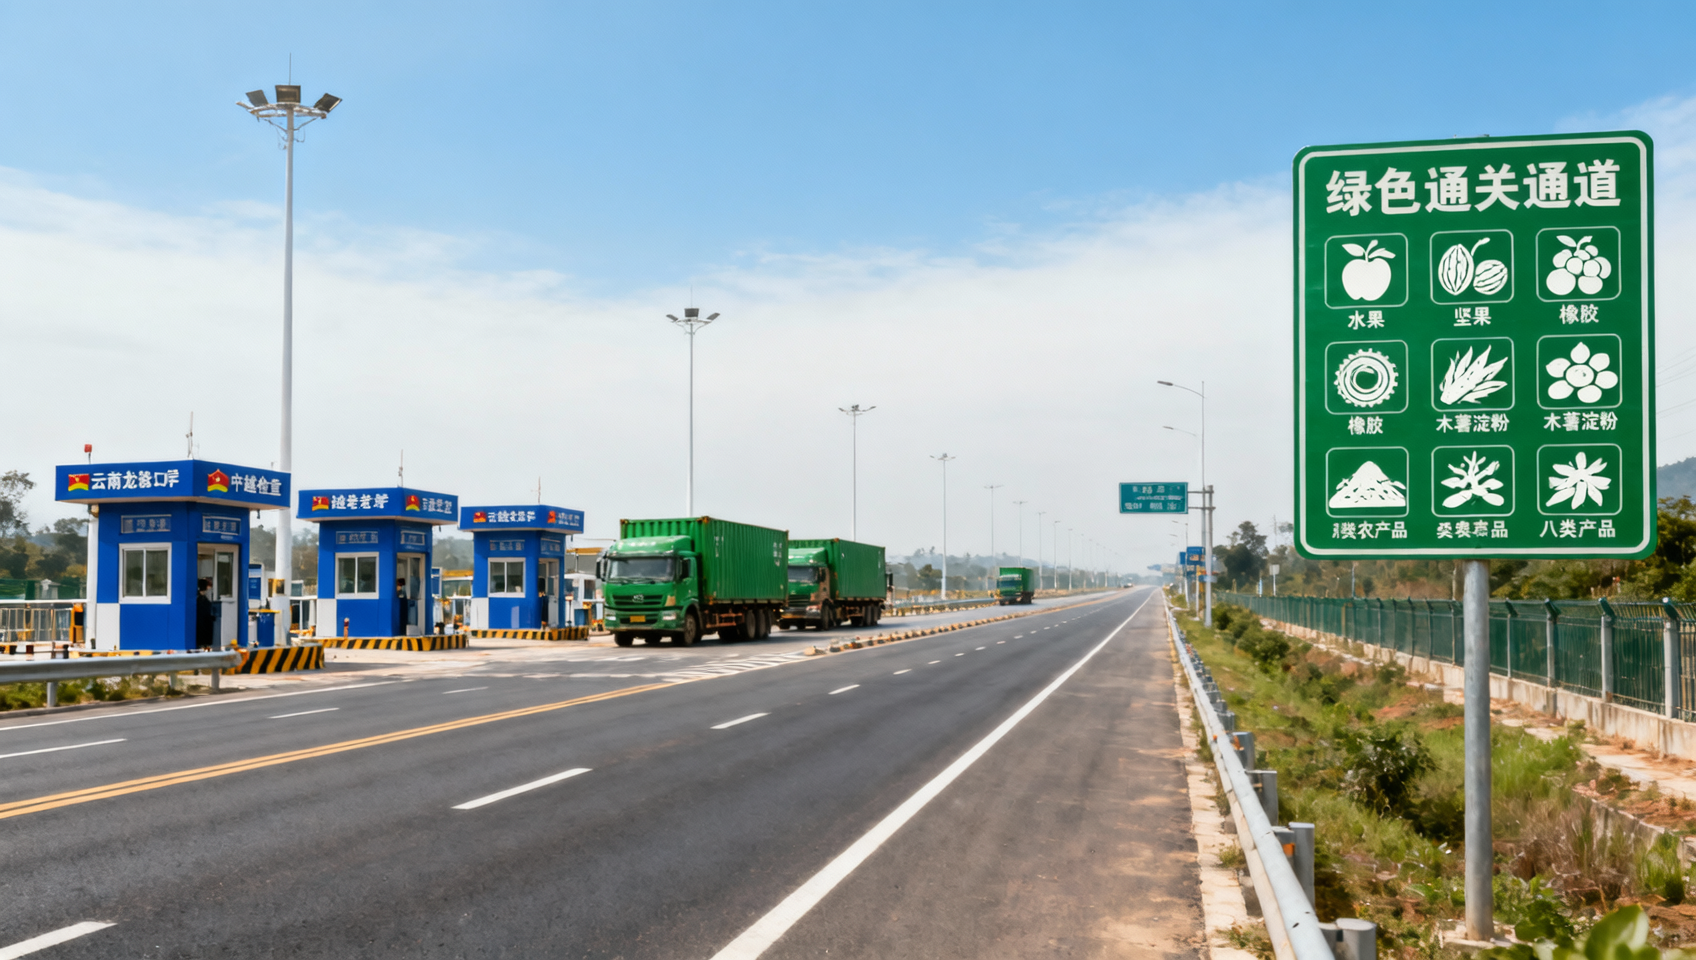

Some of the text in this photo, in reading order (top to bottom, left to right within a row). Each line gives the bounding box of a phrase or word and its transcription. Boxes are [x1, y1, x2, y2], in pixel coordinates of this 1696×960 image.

[1326, 159, 1621, 216] 绿色通关通道
[1348, 311, 1385, 330] 水果
[1453, 307, 1492, 326] 坚果
[1559, 304, 1599, 325] 橡胶
[1347, 416, 1383, 435] 橡胶
[1436, 414, 1510, 433] 木薯淀粉
[1543, 412, 1618, 431] 木薯淀粉
[1539, 519, 1616, 539] 八类产品
